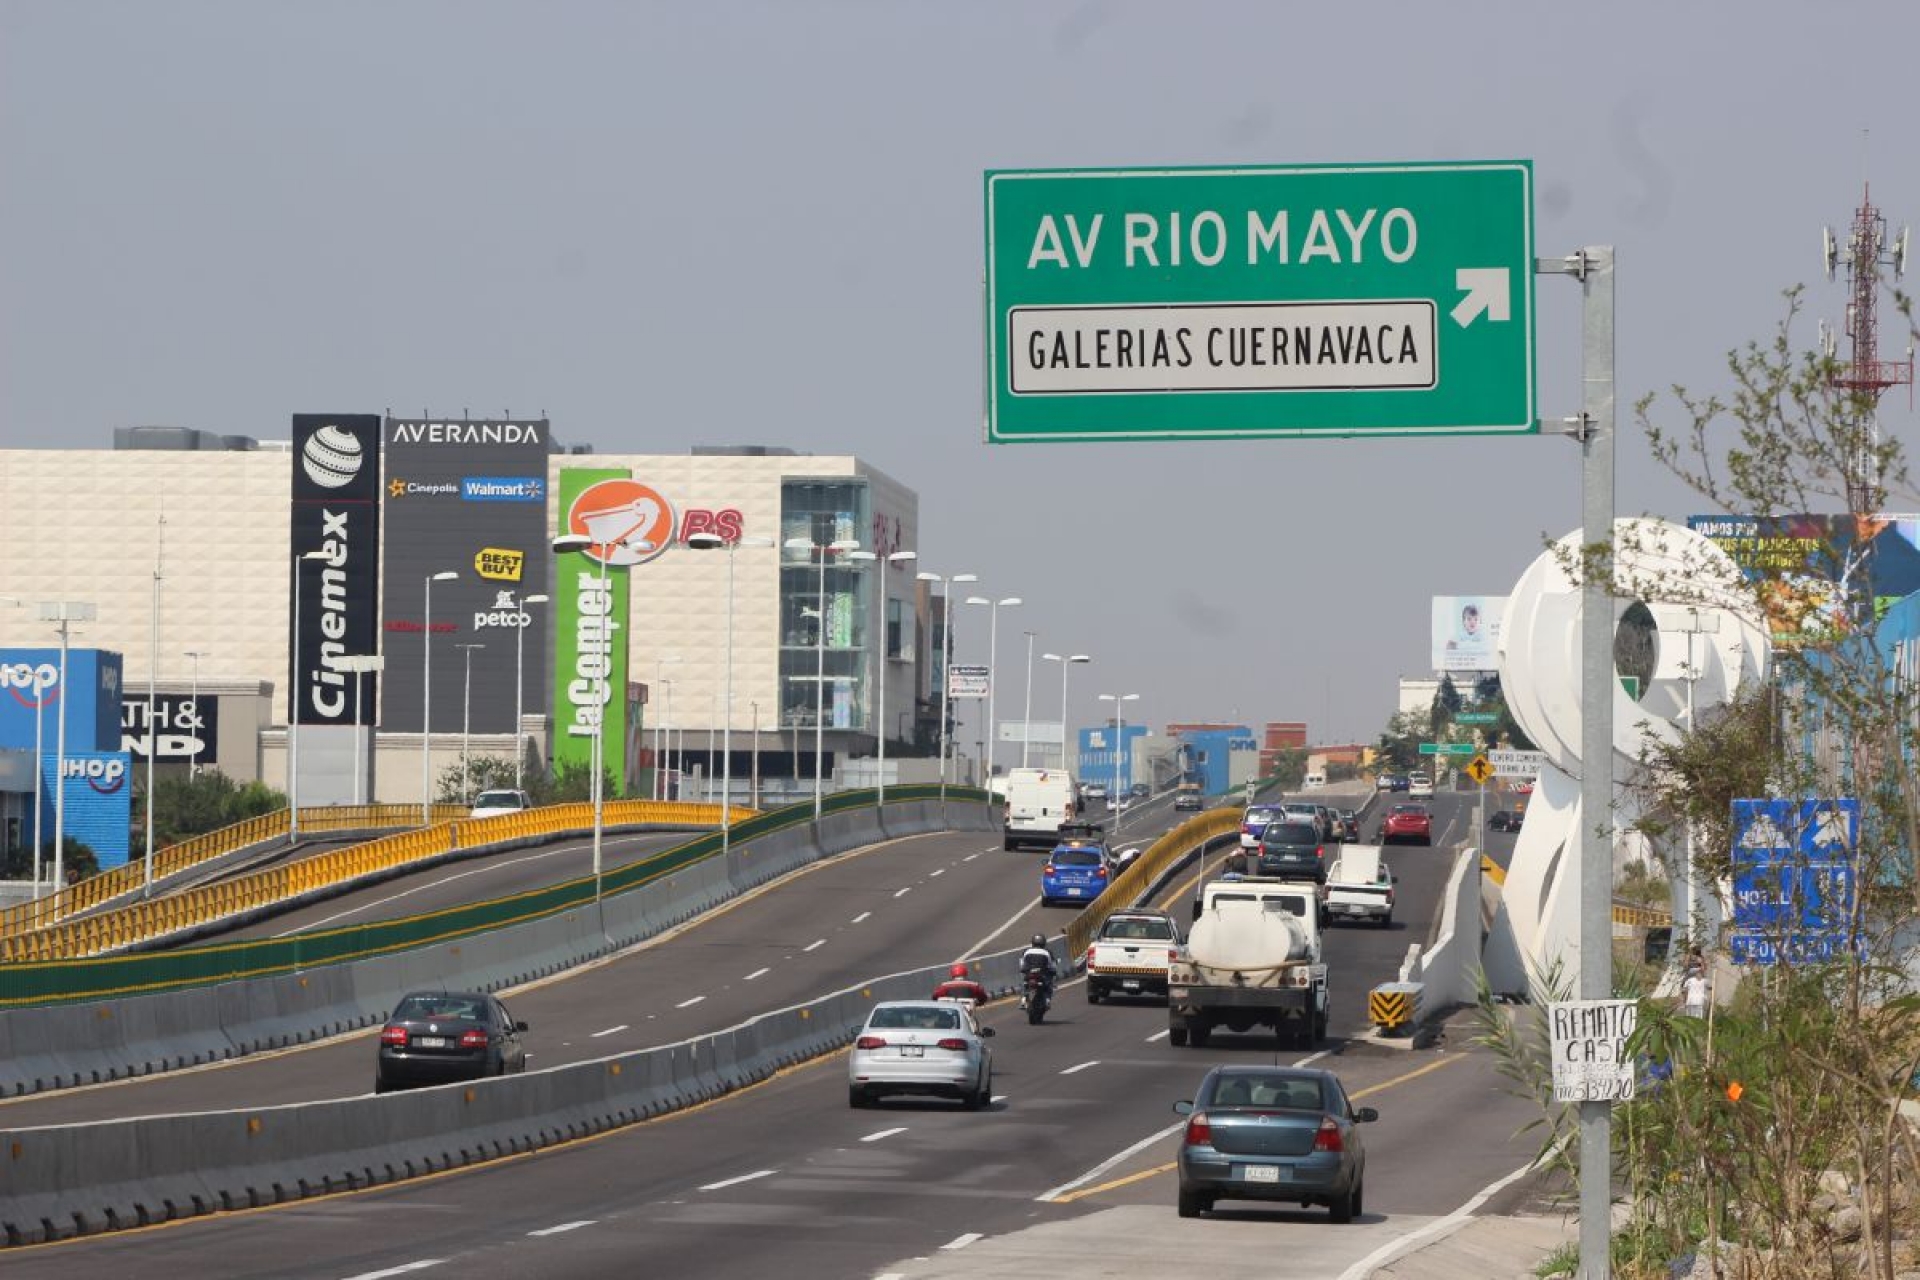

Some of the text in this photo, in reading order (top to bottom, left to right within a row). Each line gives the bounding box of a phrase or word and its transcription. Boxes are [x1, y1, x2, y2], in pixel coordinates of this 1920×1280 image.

[1026, 207, 1418, 270] AV RIO MAYO
[1029, 323, 1419, 370] GALERIAS CUERNAVACA
[393, 423, 539, 444] AVERANDA
[466, 482, 524, 496] Walmart
[482, 553, 521, 566] BEST
[482, 563, 516, 575] BUY
[311, 508, 348, 718] Cinemex
[474, 609, 532, 630] petco
[1554, 1004, 1633, 1040] REMATO
